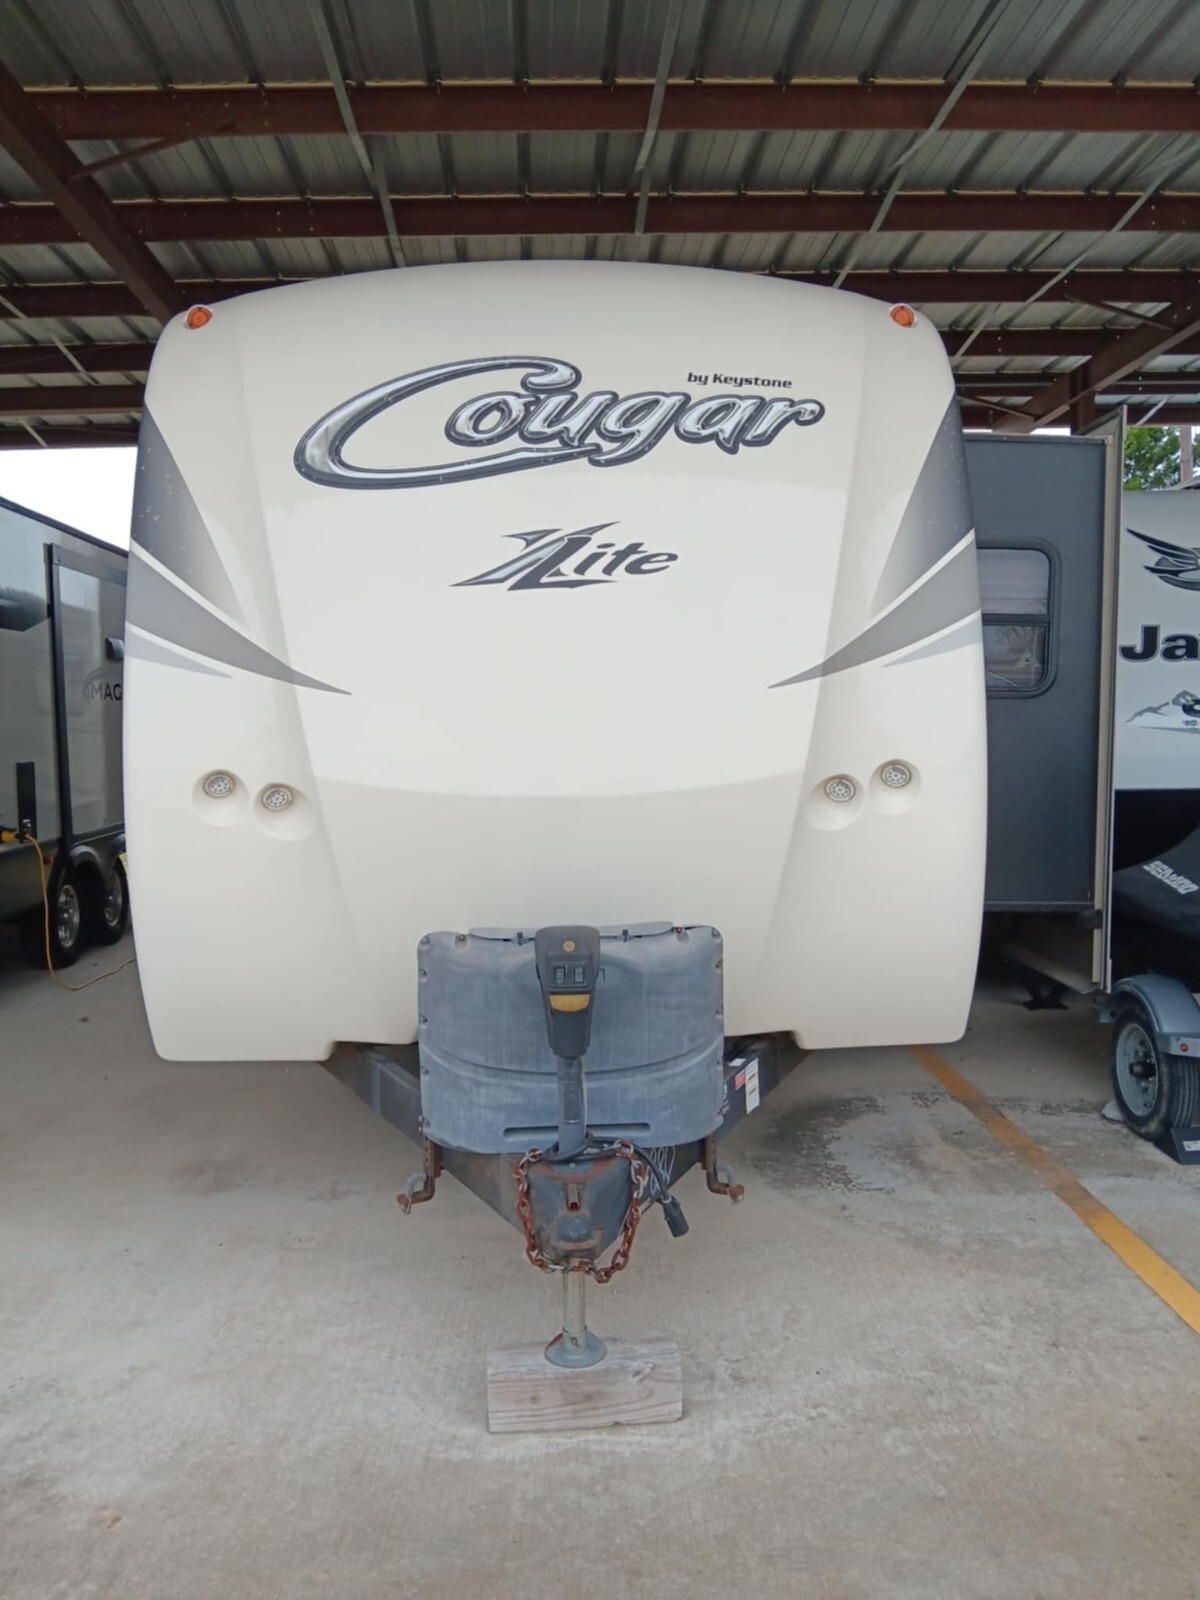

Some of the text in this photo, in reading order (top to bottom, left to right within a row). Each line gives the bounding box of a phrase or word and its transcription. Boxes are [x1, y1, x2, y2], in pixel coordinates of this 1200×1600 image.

[687, 372, 792, 388] by Keystone
[294, 356, 825, 490] Cougar
[1119, 624, 1200, 662] Ja
[87, 682, 123, 701] IMAG
